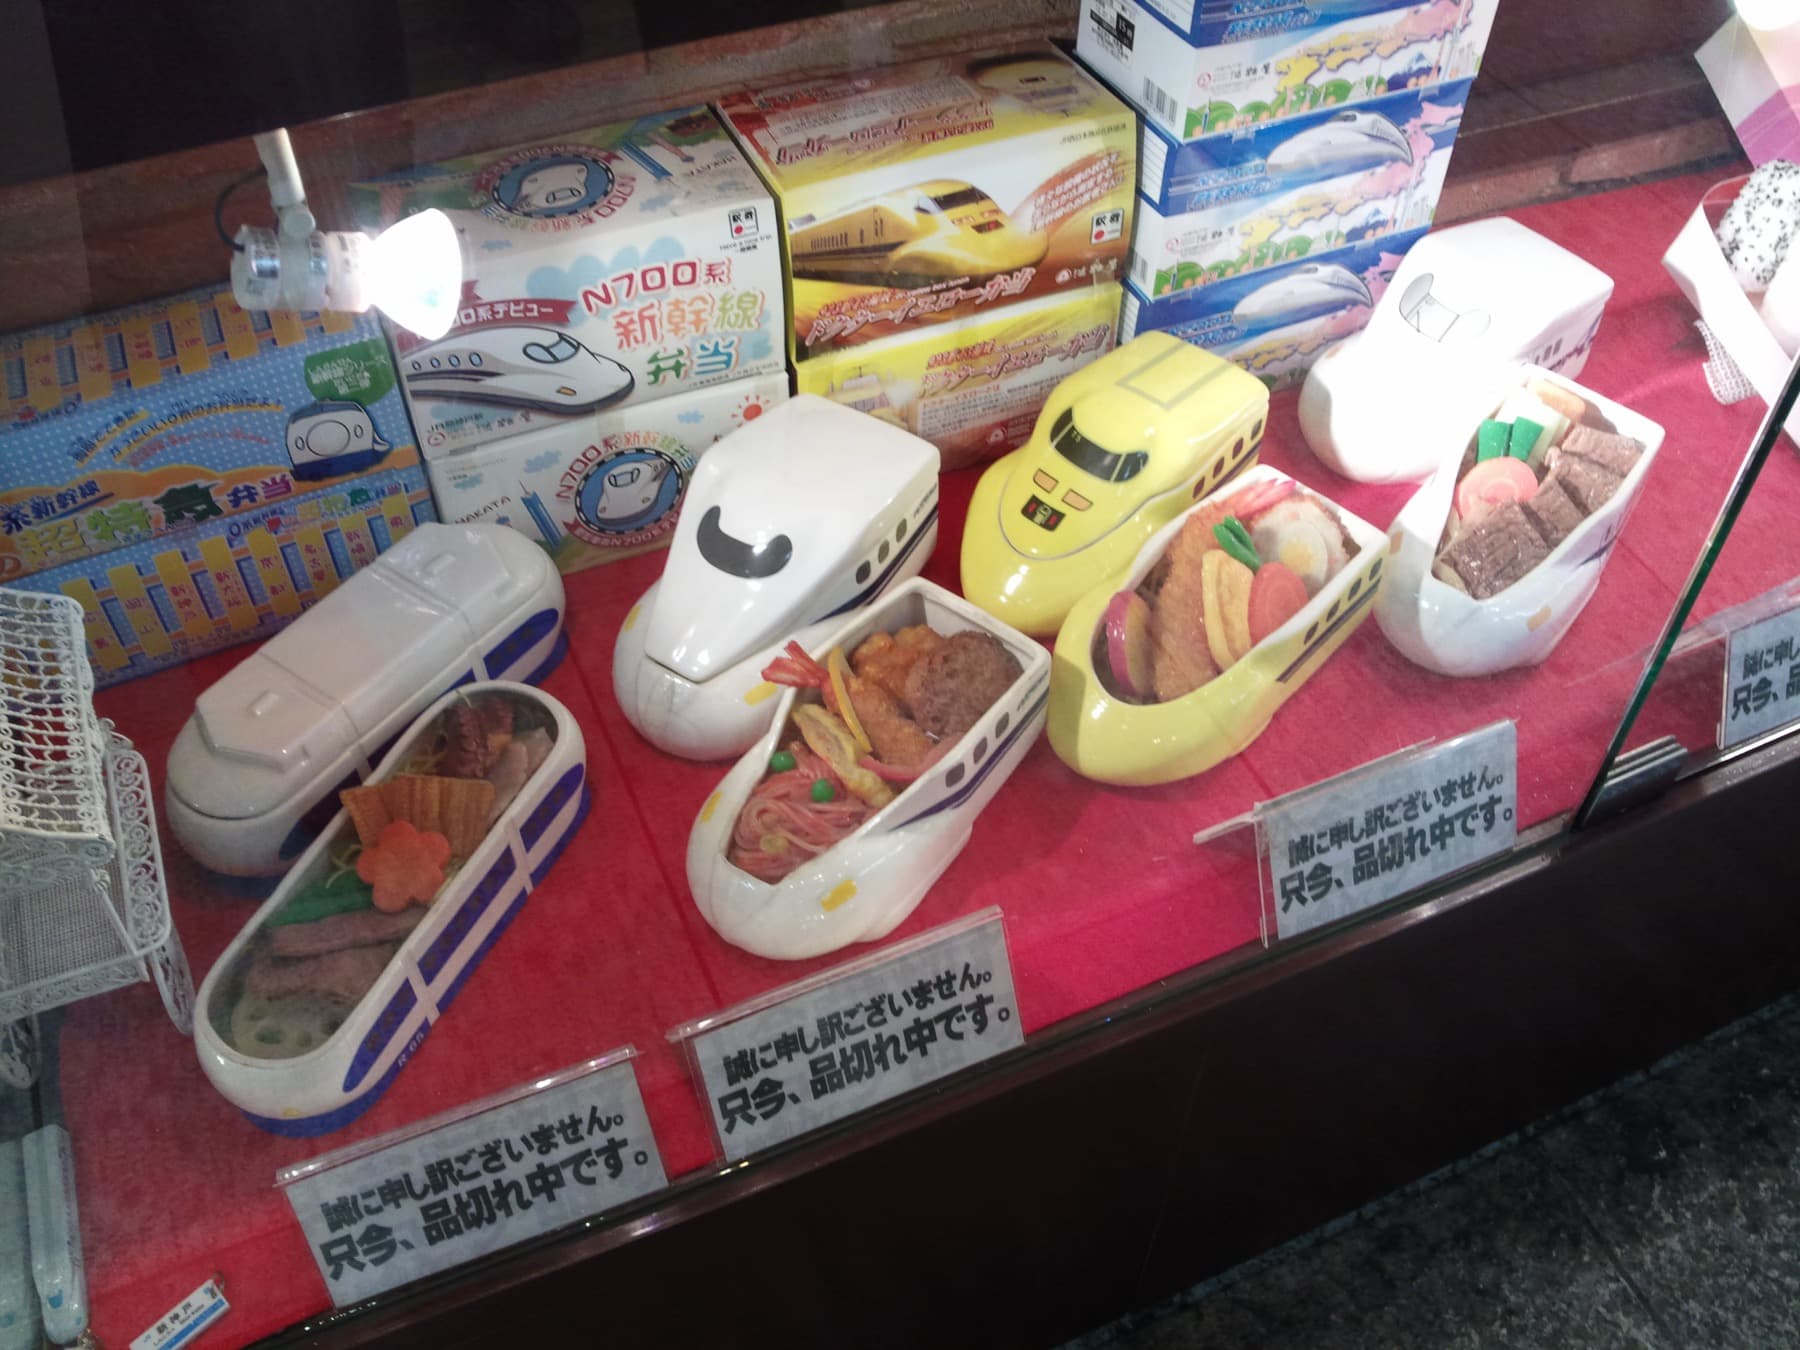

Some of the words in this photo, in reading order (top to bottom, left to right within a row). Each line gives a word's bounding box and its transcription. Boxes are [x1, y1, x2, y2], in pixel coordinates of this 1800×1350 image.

[581, 260, 729, 314] N700系
[613, 290, 760, 351] 新幹線
[646, 339, 736, 385] 弁当
[1279, 795, 1514, 913] 只今、品切れ中です。
[1287, 765, 1504, 868] 誠に申し訳ございません。
[716, 994, 1011, 1135] 只今、品切れ中です。
[722, 962, 992, 1086] 誠に申し訳ございません。
[318, 1137, 650, 1282] 只今、品切れ中です。
[319, 1104, 625, 1235] 誠に申し訳ございません。
